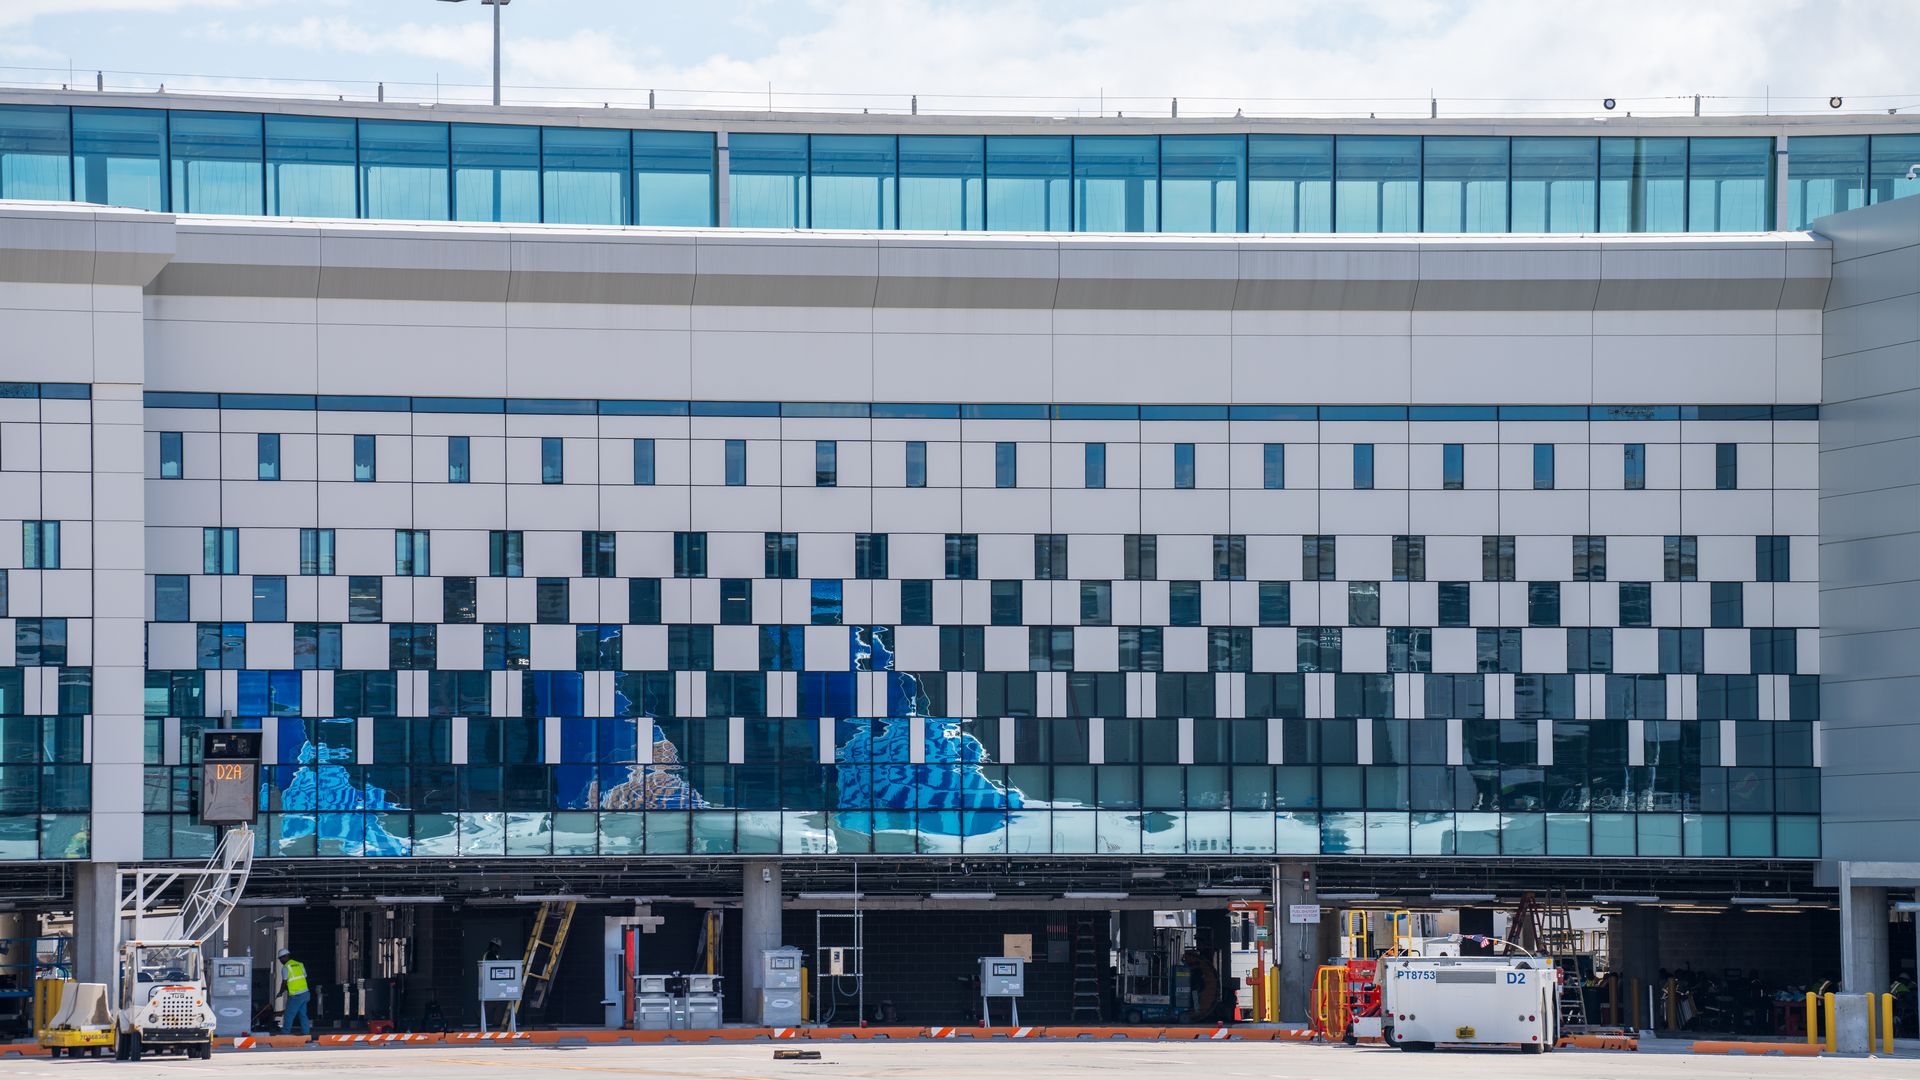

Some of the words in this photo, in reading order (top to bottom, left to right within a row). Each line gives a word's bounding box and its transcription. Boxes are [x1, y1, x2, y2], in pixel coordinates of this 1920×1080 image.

[217, 764, 241, 780] D2A
[1397, 970, 1436, 979] PT8753
[1507, 972, 1526, 984] D2
